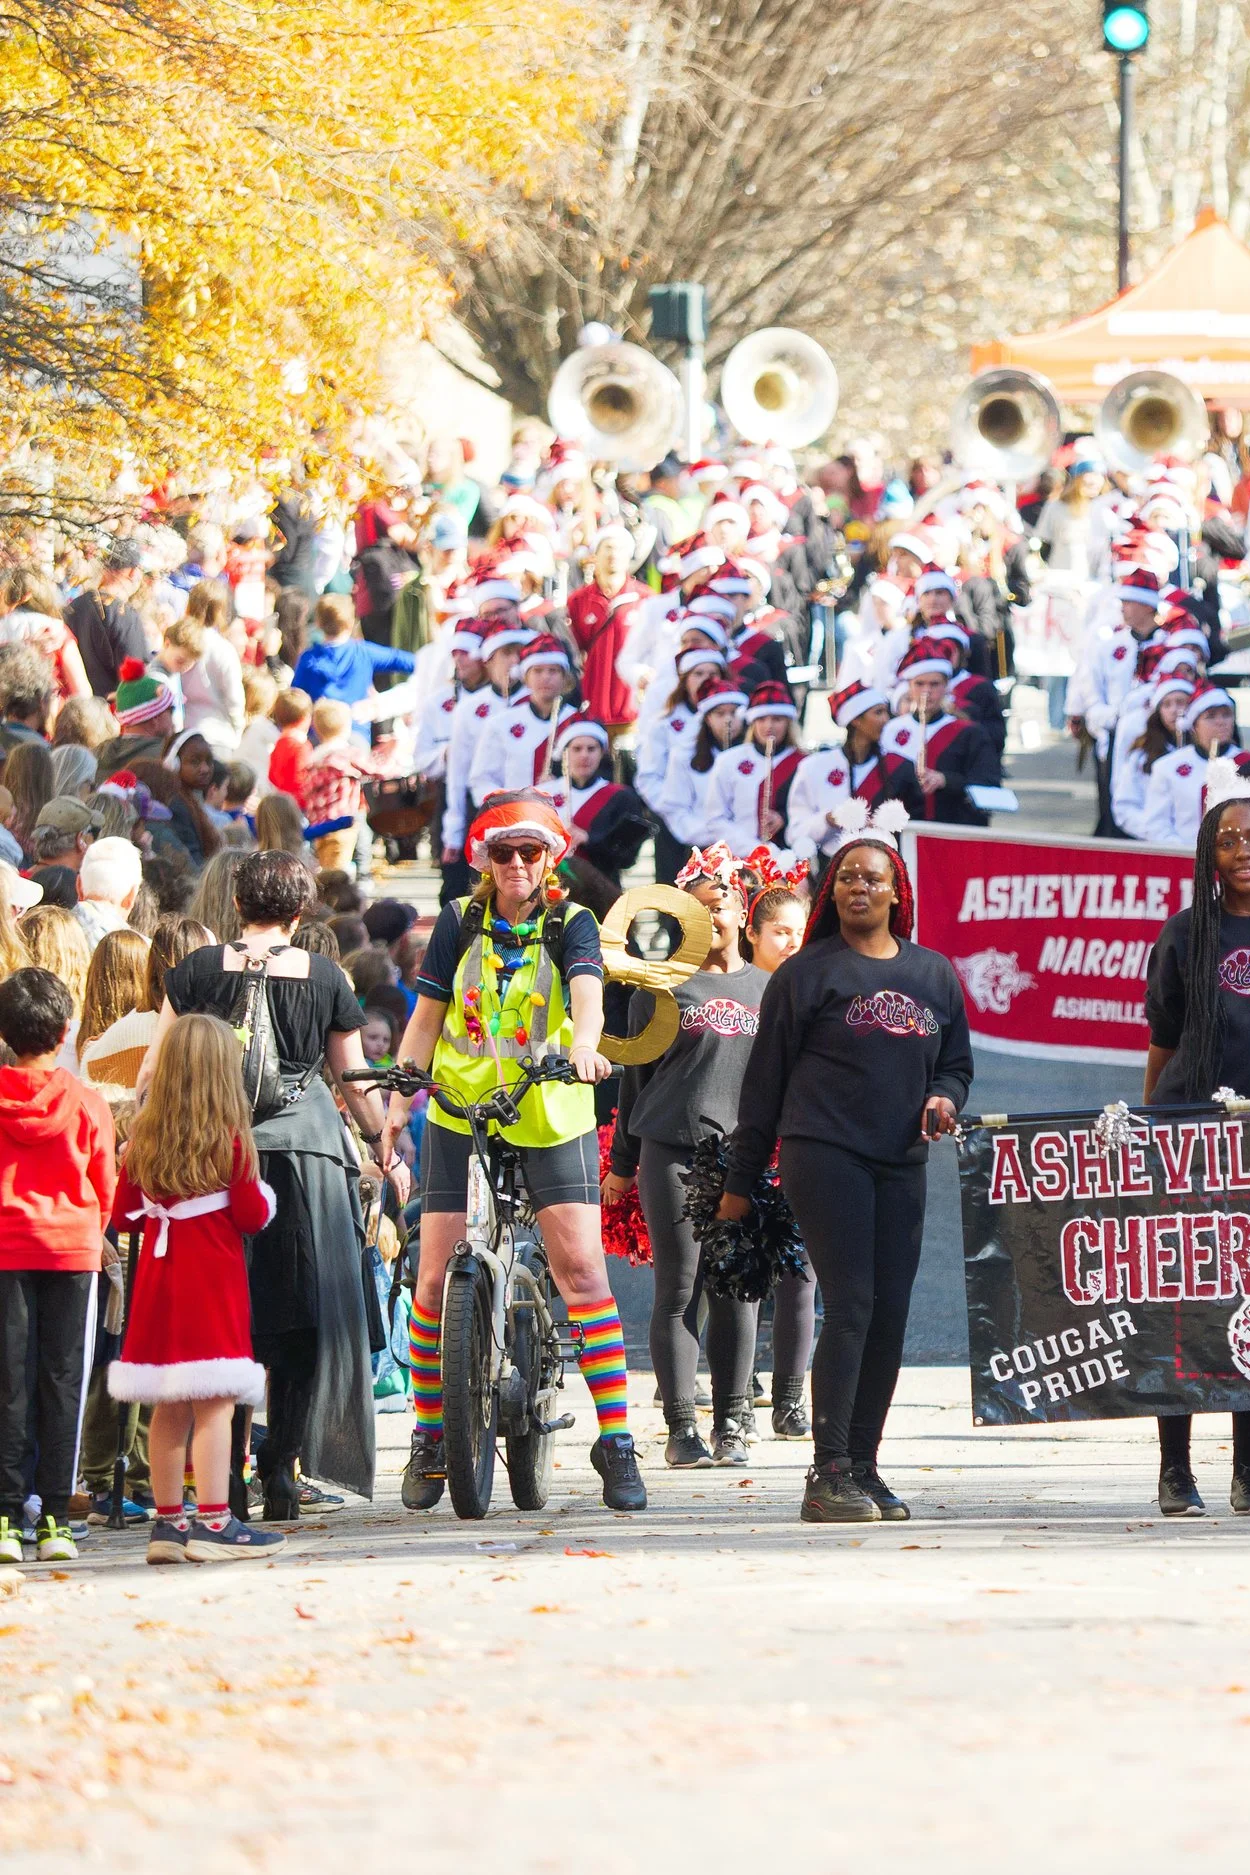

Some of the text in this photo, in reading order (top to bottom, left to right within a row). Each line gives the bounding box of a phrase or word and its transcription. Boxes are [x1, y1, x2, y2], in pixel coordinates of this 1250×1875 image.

[958, 874, 1170, 923] ASHEVILLE
[989, 1310, 1138, 1383] COUGAR
[1019, 1349, 1130, 1411] PRIDE
